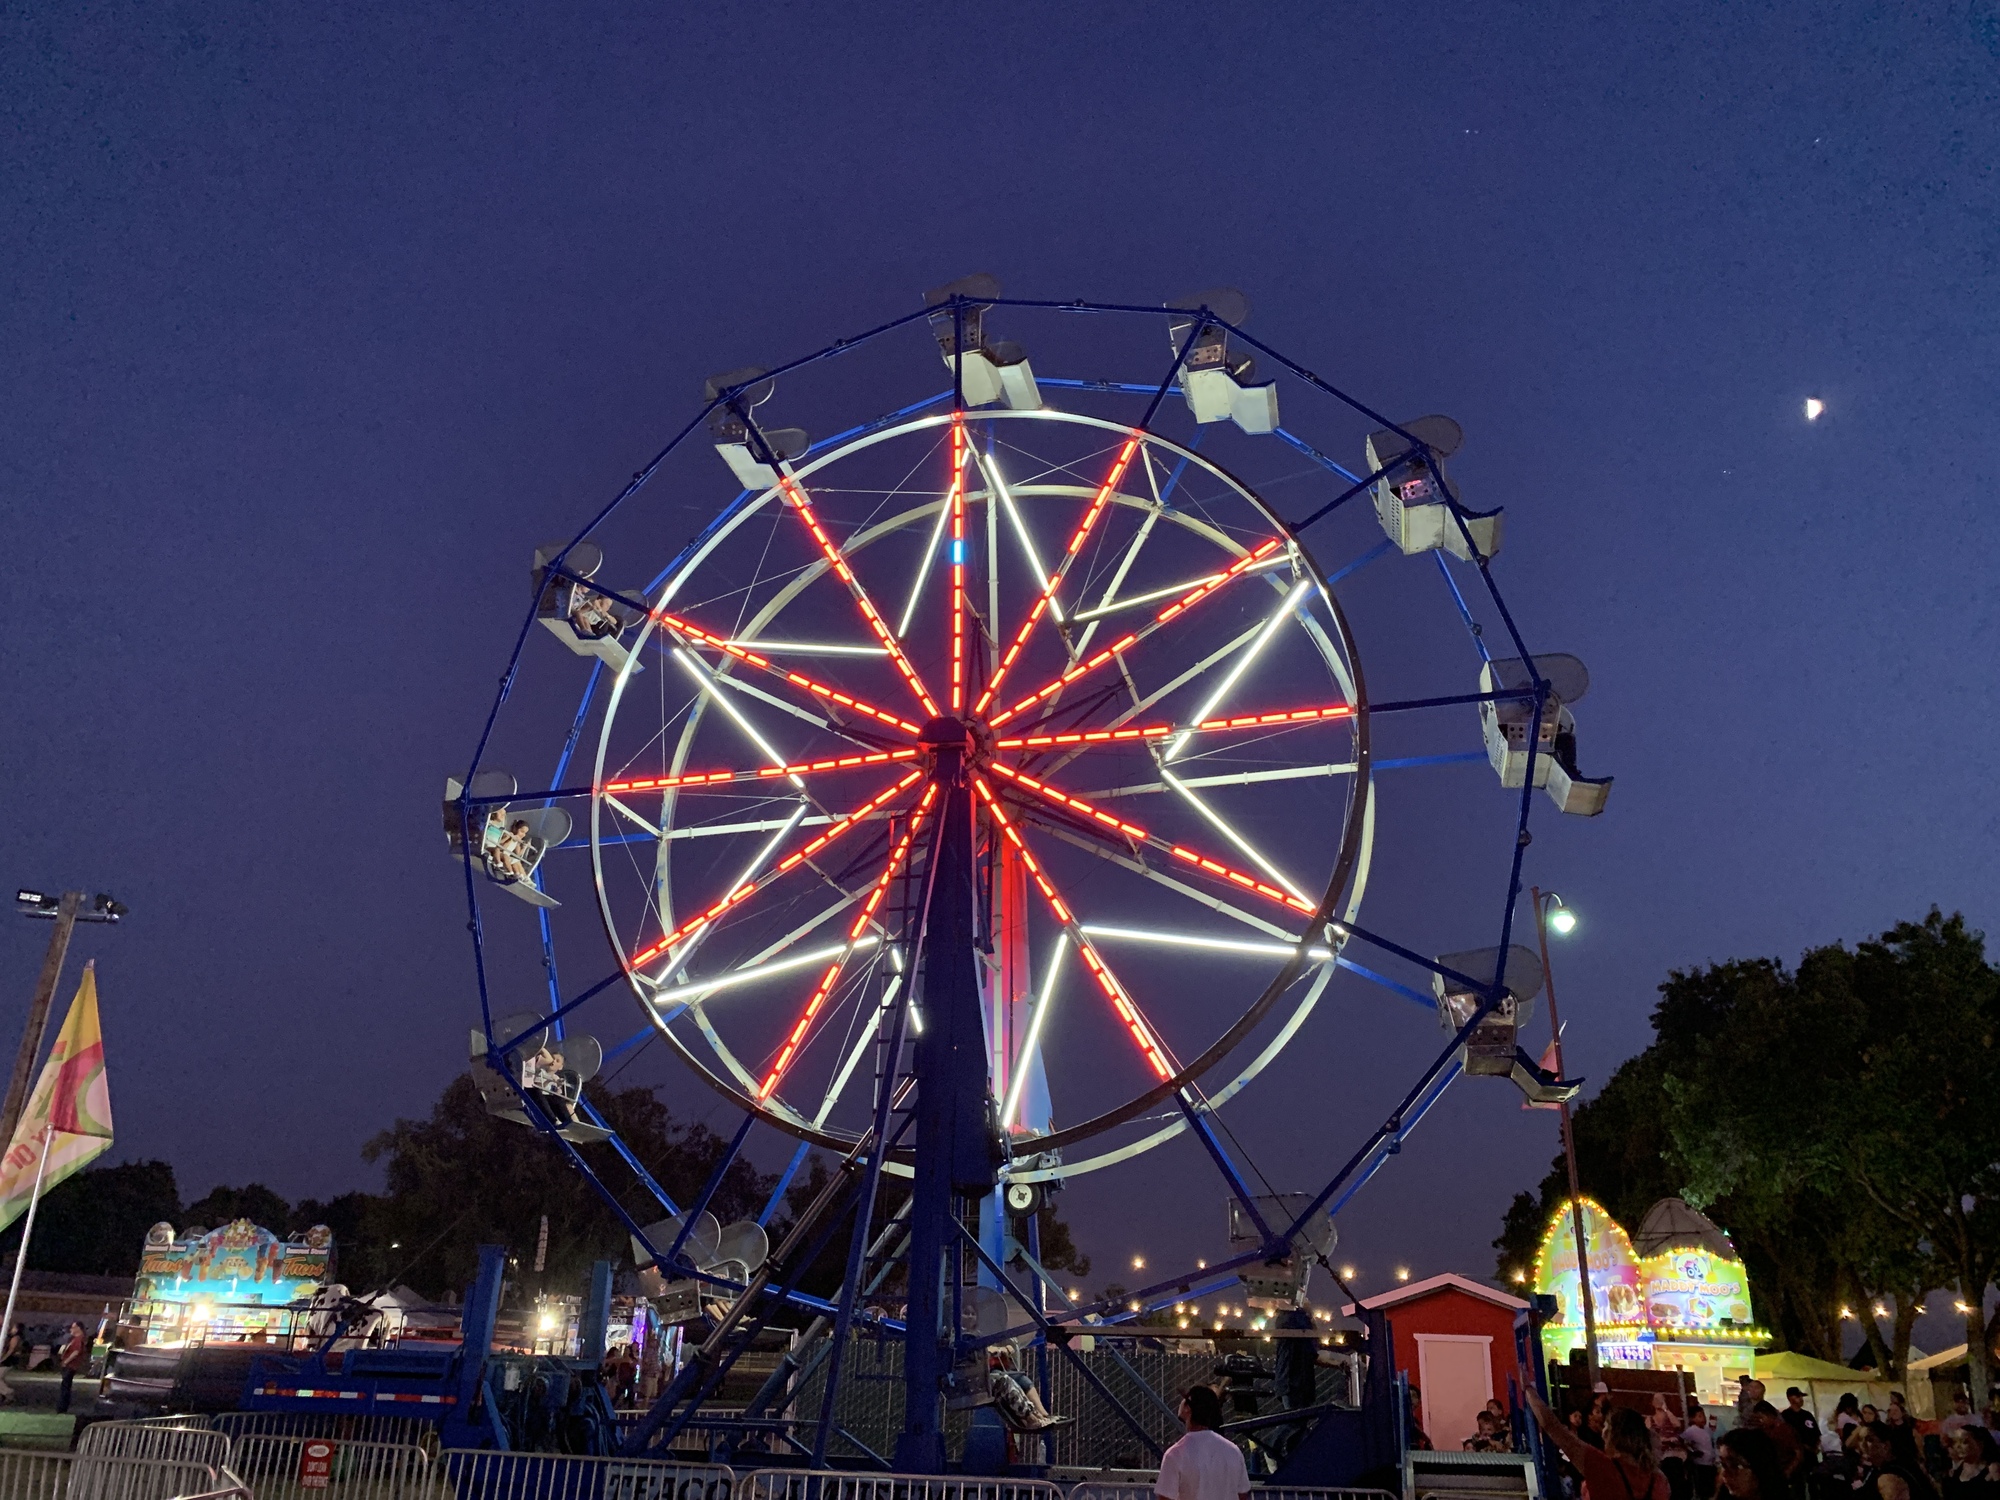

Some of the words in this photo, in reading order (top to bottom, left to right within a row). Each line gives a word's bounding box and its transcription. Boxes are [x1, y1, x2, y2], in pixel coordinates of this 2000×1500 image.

[142, 1253, 183, 1274] Tacos
[283, 1256, 325, 1276] Tacos
[1650, 1280, 1696, 1295] MADDY
[1698, 1281, 1741, 1296] MOO'S
